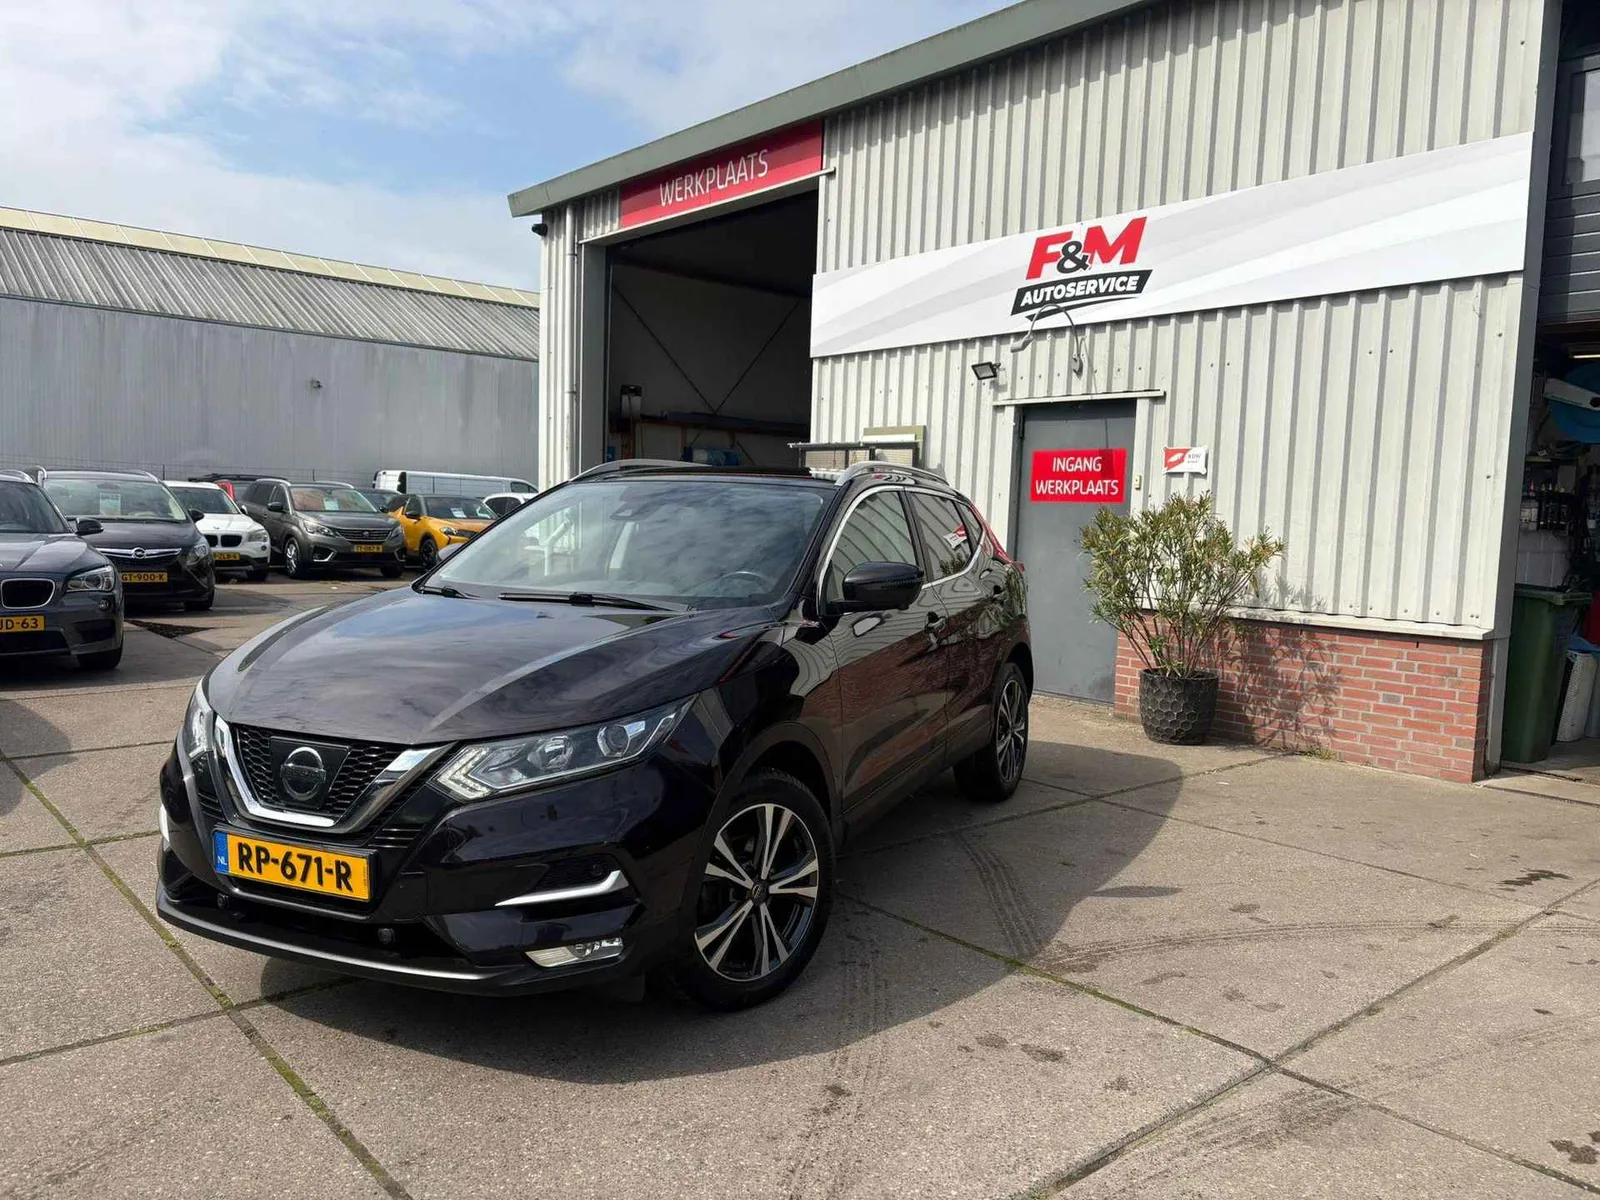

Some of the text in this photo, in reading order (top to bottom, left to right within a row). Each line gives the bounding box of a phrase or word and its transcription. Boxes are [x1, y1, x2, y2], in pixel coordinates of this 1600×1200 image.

[659, 149, 769, 207] WERKPLAATS
[1026, 216, 1148, 280] F&M
[1020, 275, 1140, 307] AUTOSERVICE
[1052, 456, 1103, 473] INGANG
[1035, 479, 1119, 496] WERKPLAATS
[121, 572, 165, 582] GT-900-K
[217, 855, 227, 866] NL
[237, 842, 353, 893] RP-671-R
